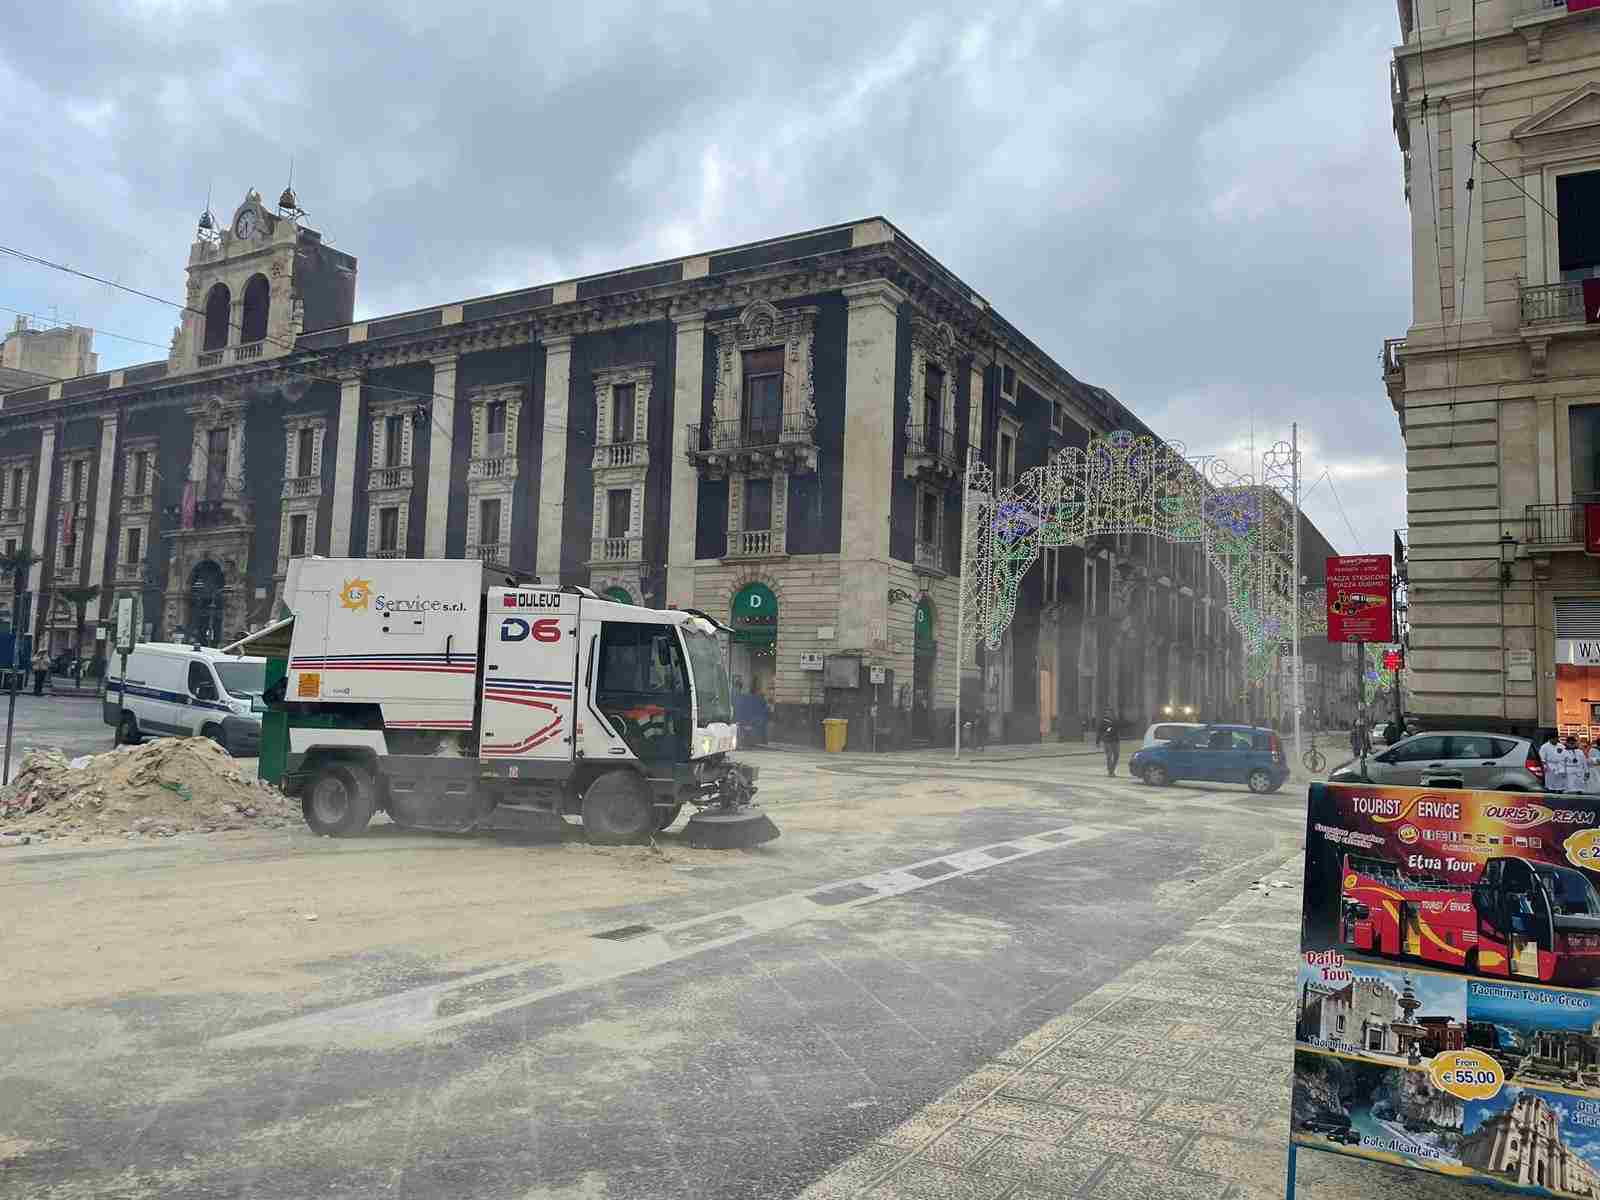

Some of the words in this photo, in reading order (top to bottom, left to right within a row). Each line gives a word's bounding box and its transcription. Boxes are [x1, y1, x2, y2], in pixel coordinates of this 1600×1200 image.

[376, 594, 441, 611] Service
[518, 593, 560, 607] DULEVO
[750, 594, 762, 608] D
[501, 618, 561, 642] D6
[1353, 797, 1400, 815] TOURiST
[1408, 854, 1441, 869] Etna
[1446, 857, 1477, 872] Tour
[1306, 950, 1345, 968] Daily
[1321, 967, 1353, 982] Tour
[1472, 984, 1521, 1000] Taormina
[1558, 994, 1591, 1009] Greco
[1455, 1058, 1479, 1067] From
[1455, 1070, 1496, 1085] 55,00
[1388, 1139, 1440, 1159] Alcantara
